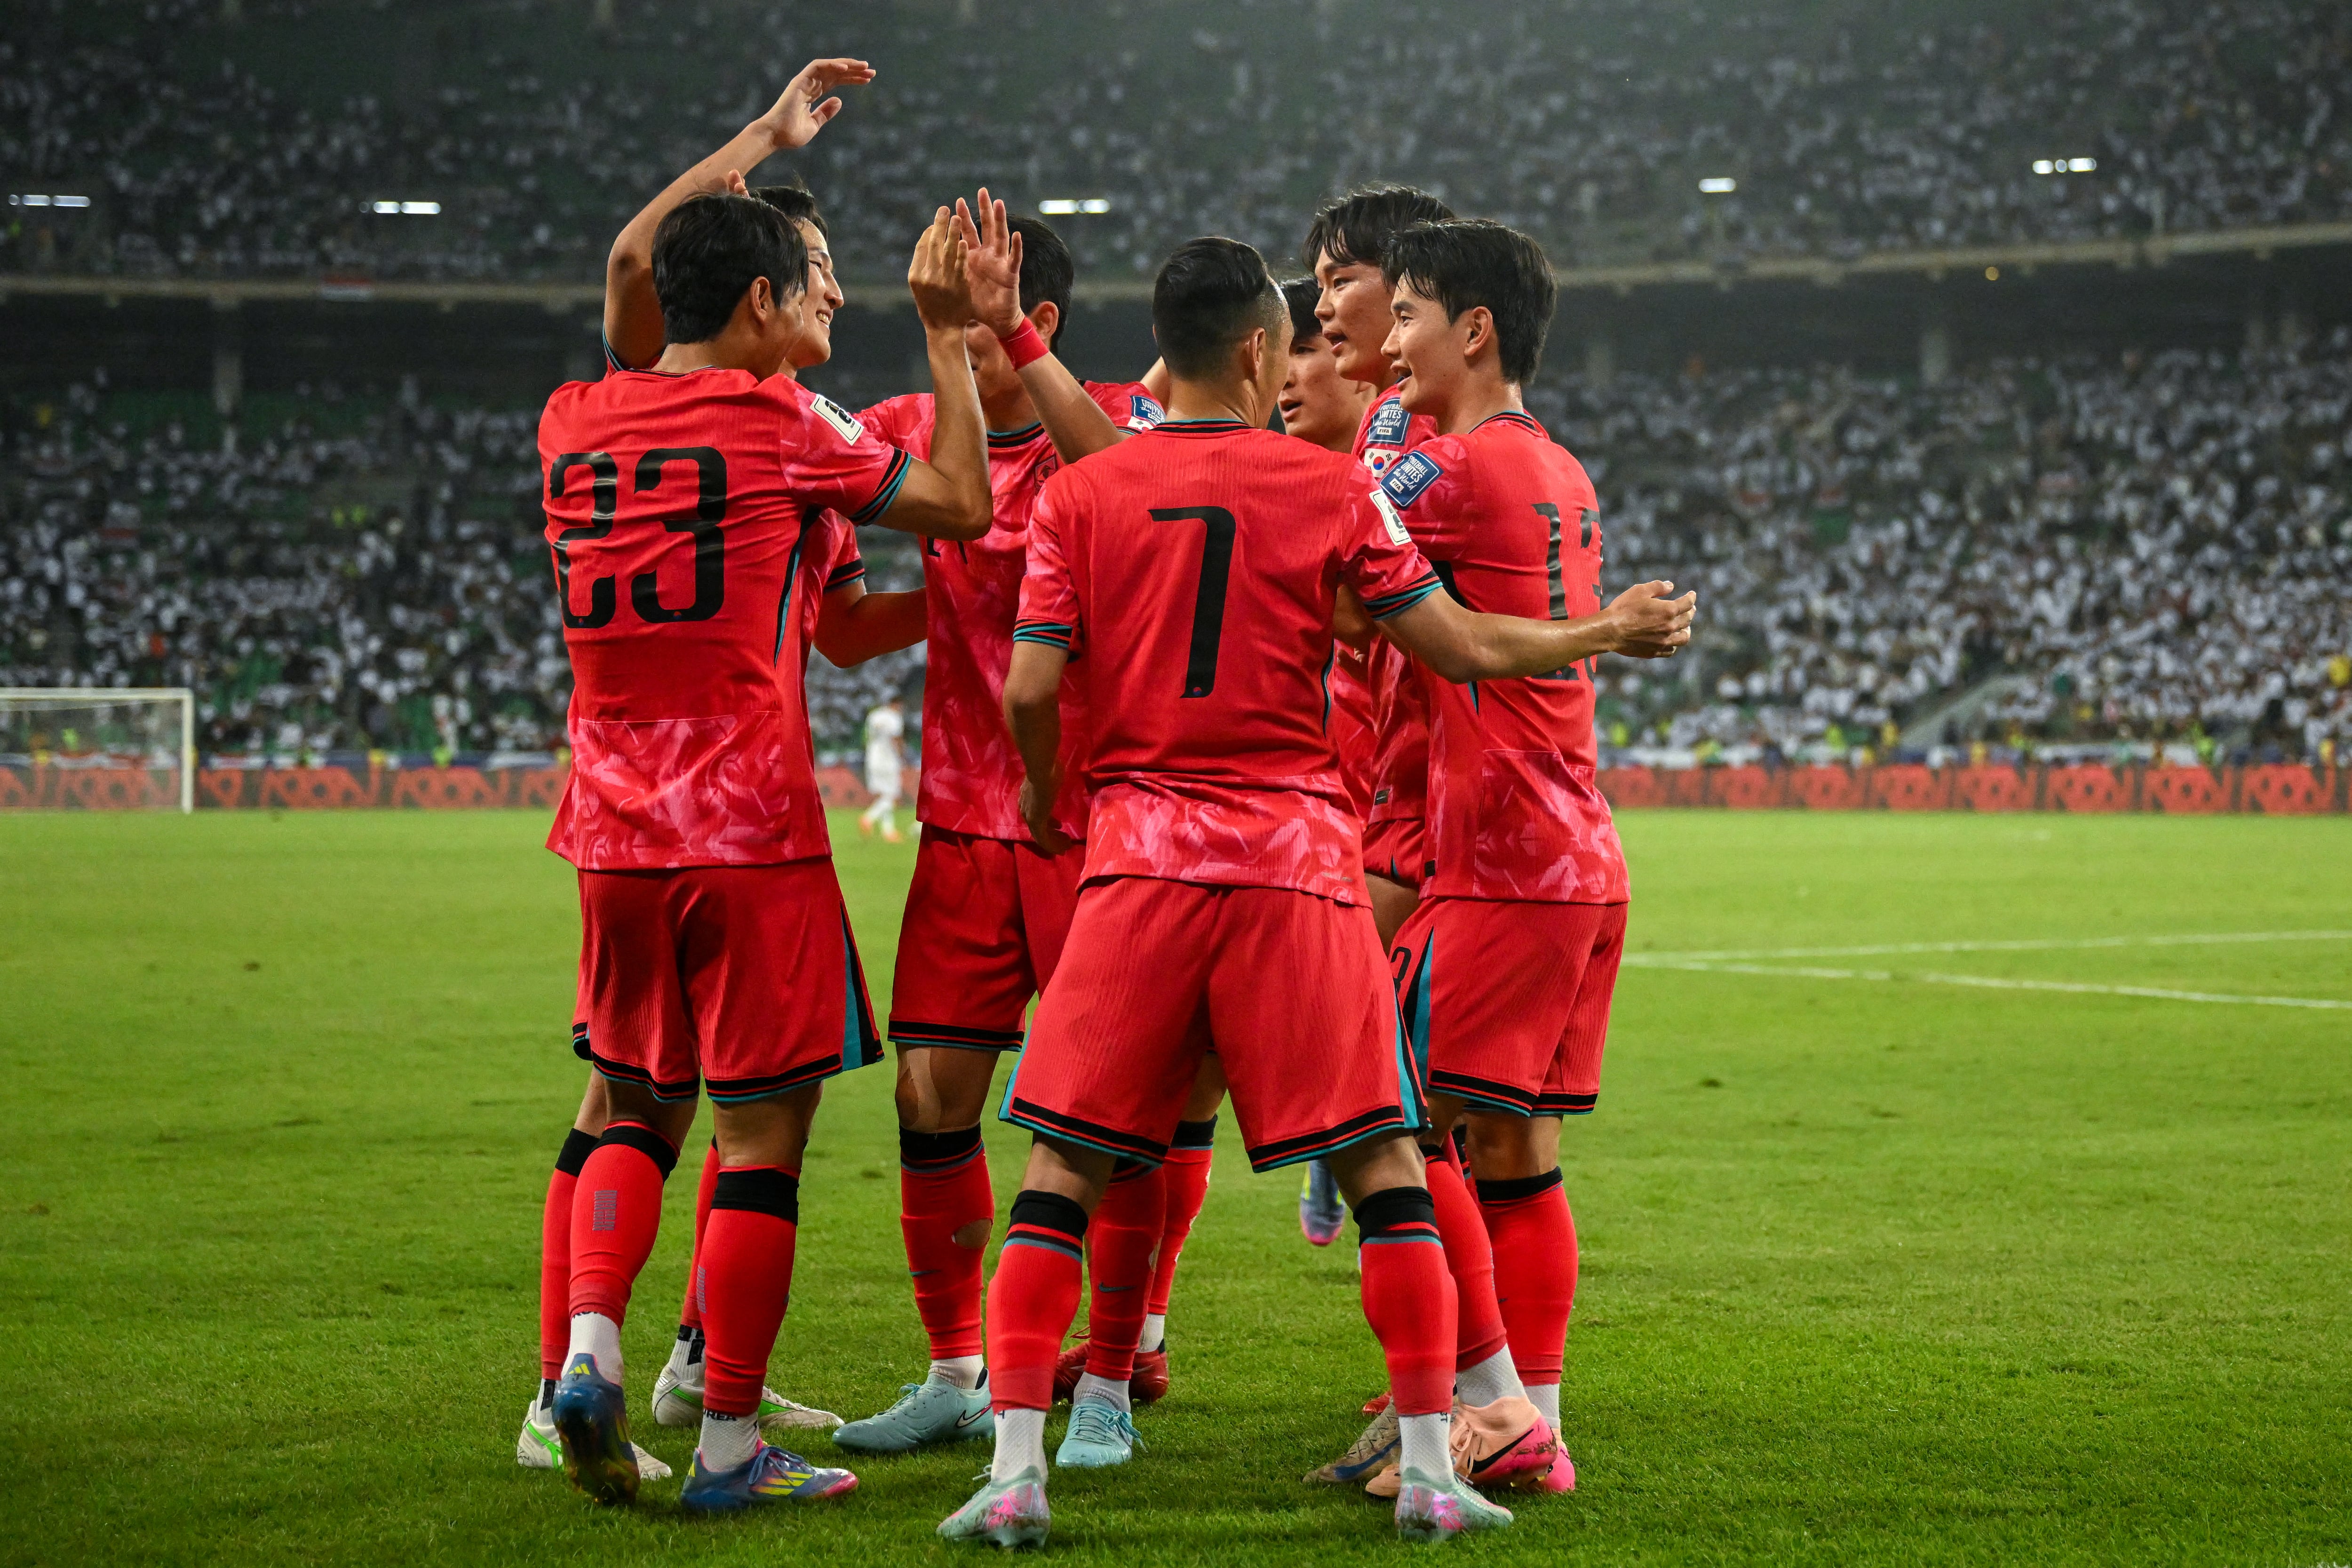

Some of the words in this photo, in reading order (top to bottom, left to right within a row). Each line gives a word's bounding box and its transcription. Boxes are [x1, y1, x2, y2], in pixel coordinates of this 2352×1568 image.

[1383, 418, 1401, 428] World
[1401, 462, 1422, 482] UNITES
[1408, 455, 1428, 476] FOOTBALL
[1392, 481, 1401, 490] FIFA
[1393, 468, 1401, 477] the
[1399, 473, 1417, 491] World
[549, 446, 727, 629] 23
[1147, 506, 1236, 698] 7
